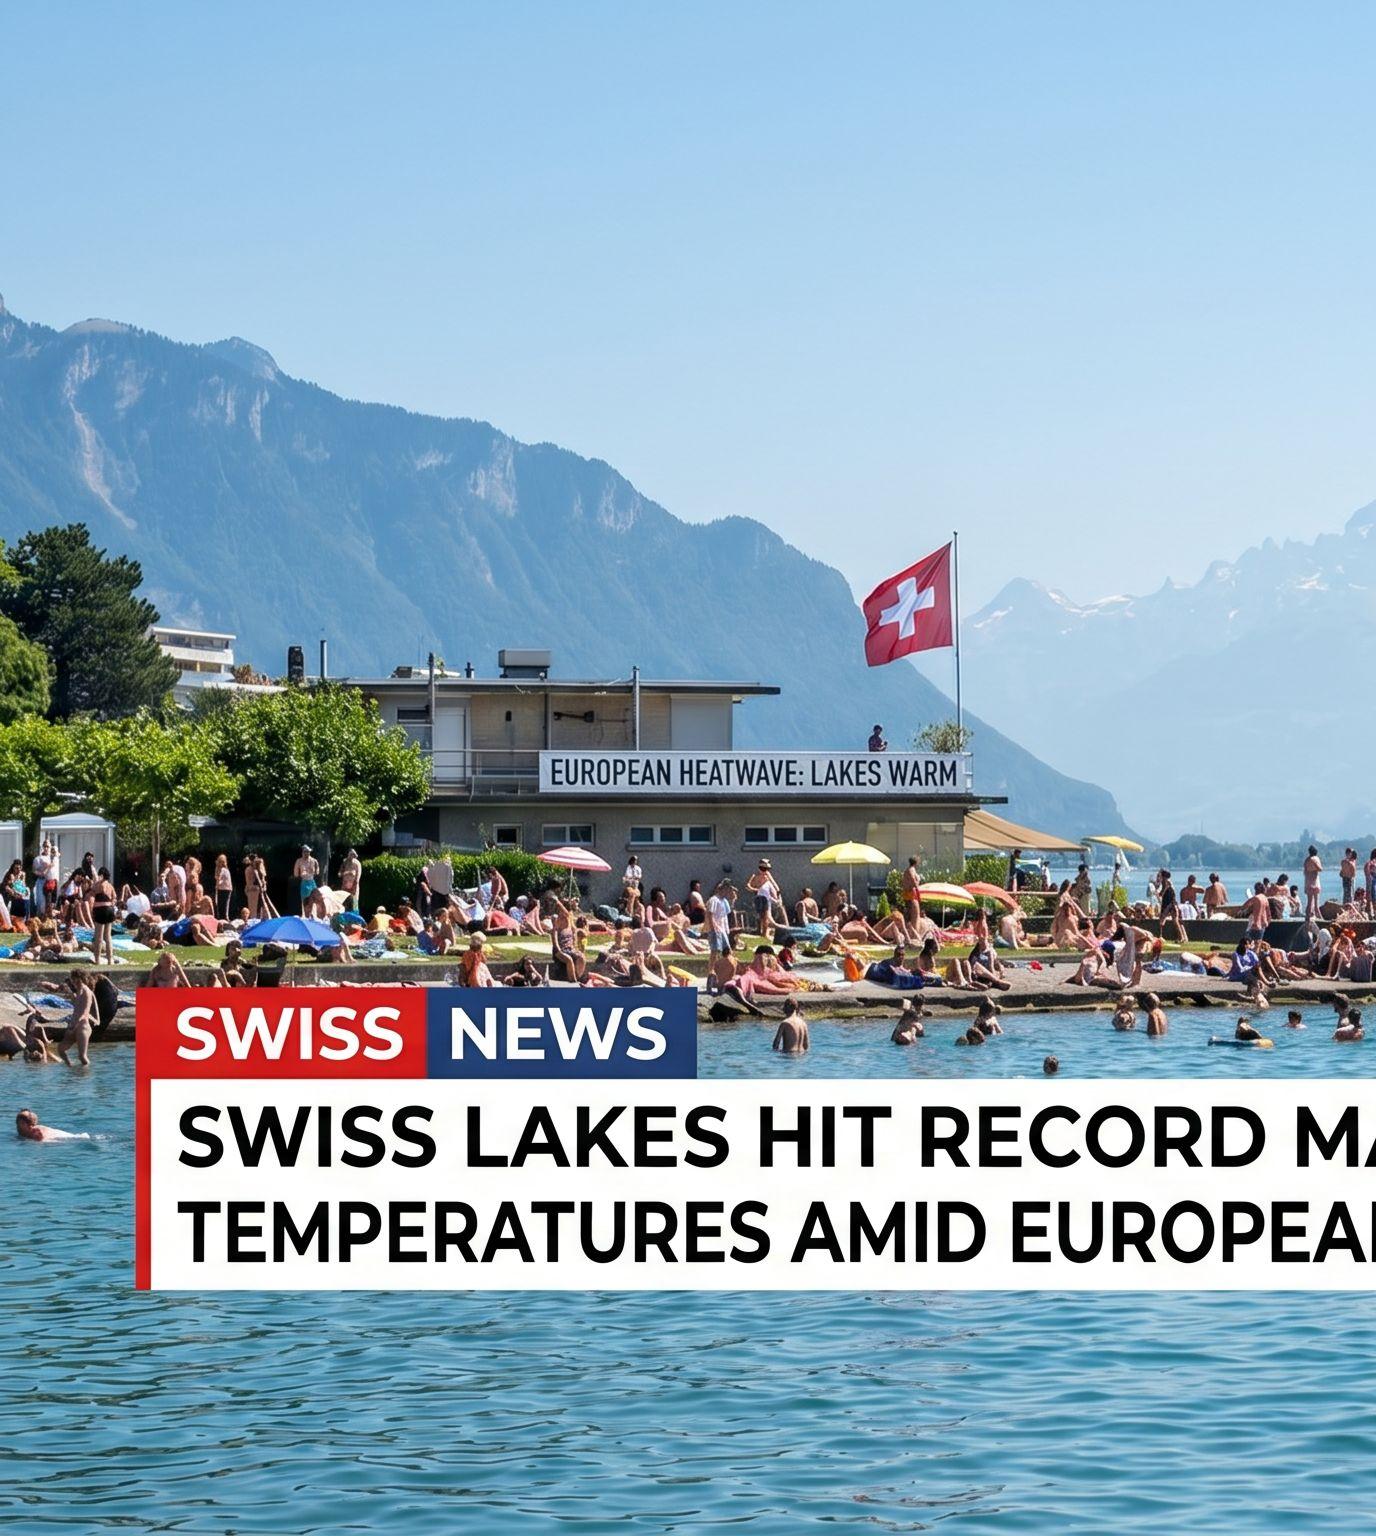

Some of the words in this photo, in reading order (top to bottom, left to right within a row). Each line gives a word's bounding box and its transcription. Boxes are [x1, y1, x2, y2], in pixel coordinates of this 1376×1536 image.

[551, 758, 671, 787] EUROPEAN
[679, 758, 804, 787] HEATWAVE:
[811, 758, 882, 787] LAKES
[887, 759, 958, 787] WARM
